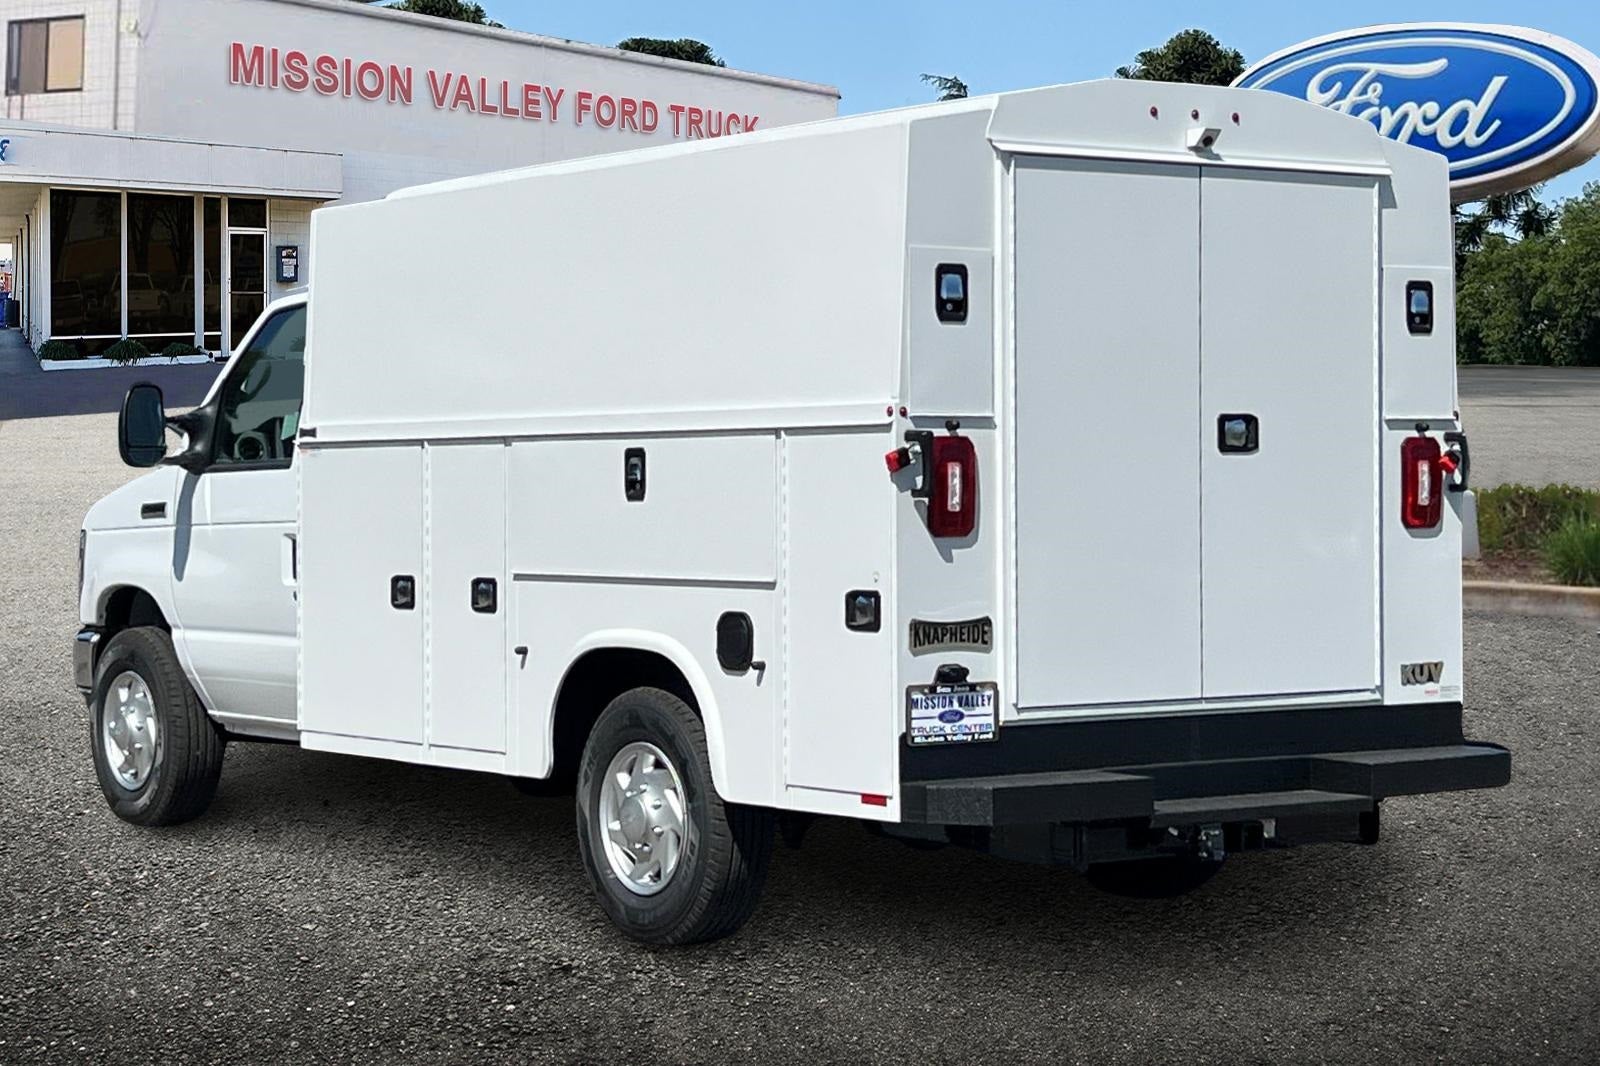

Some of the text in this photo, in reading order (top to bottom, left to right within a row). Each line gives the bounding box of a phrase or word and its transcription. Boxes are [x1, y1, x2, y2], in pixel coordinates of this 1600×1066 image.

[229, 41, 760, 138] MISSION VALLEY FORD TRUCK
[913, 622, 989, 648] KNAPHEIDE
[1400, 661, 1444, 686] KUV
[911, 694, 992, 710] MISSION VALLEY
[911, 723, 993, 734] TRUCK CENTER
